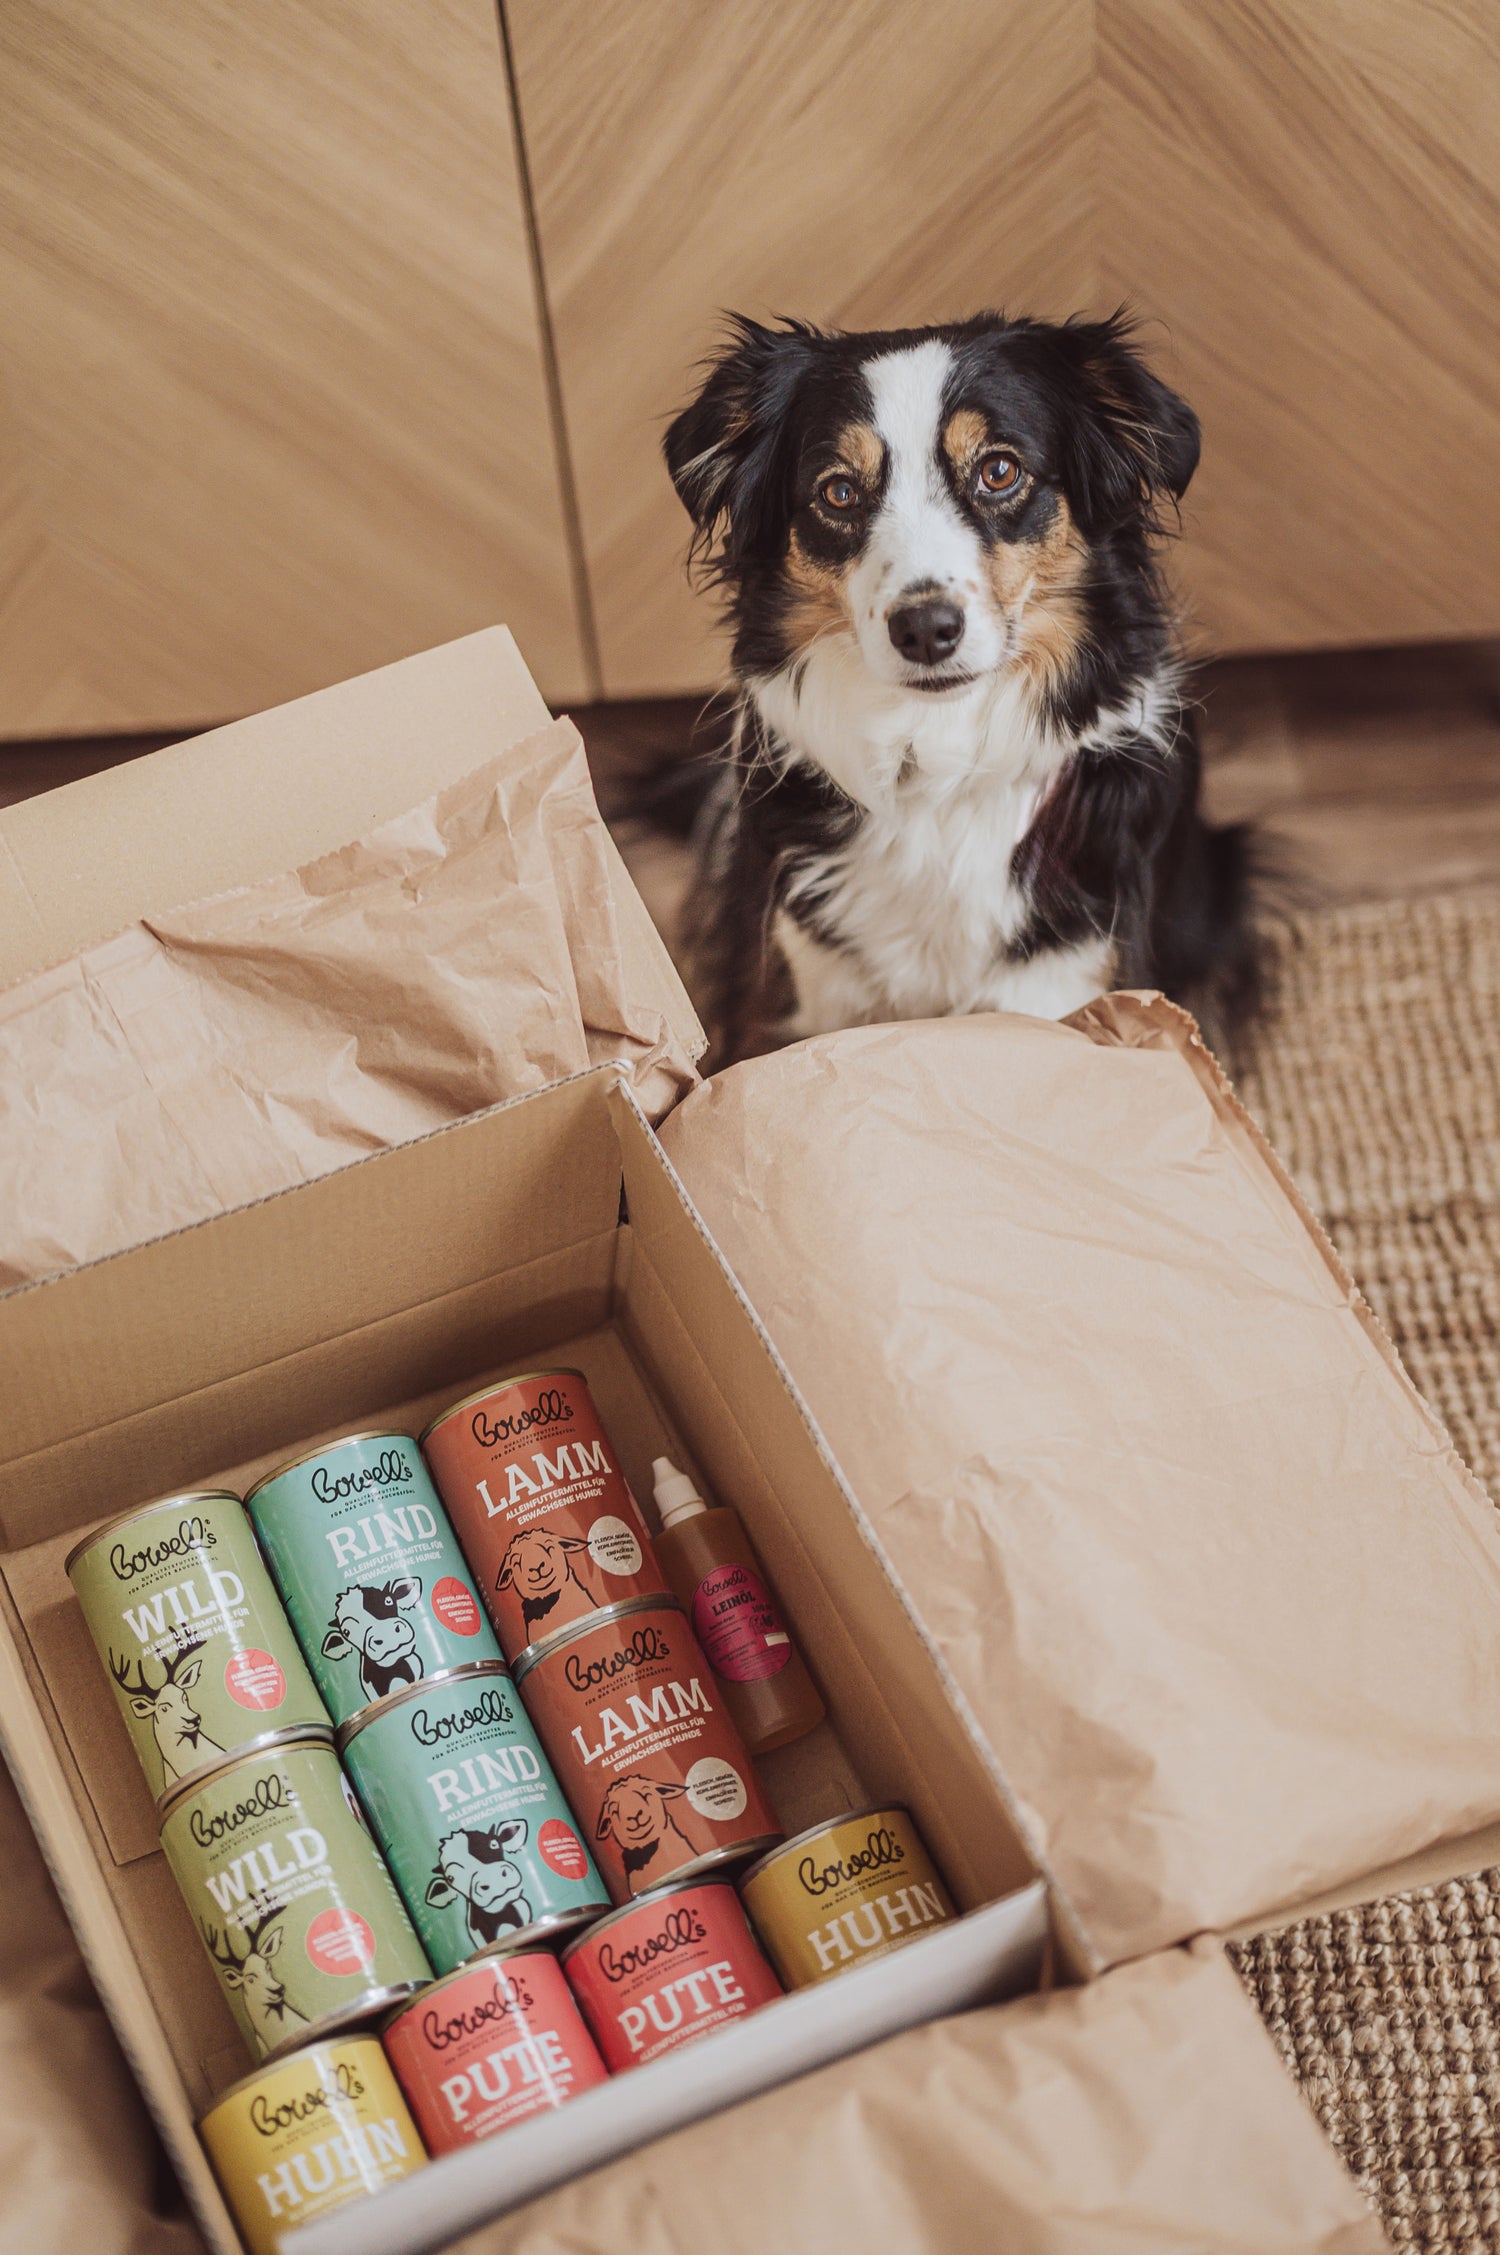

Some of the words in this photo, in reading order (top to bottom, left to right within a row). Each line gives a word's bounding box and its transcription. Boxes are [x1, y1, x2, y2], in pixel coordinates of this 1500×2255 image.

[345, 1486, 399, 1506] QUALITÄFUTTER
[476, 1440, 612, 1518] LAMM
[506, 1480, 592, 1521] ALLEINFUTTERMITTEL
[592, 1477, 606, 1488] FÜR
[518, 1495, 575, 1525] ERWACHSENE
[576, 1488, 603, 1501] HUNDE
[326, 1504, 437, 1568] RIND
[344, 1543, 430, 1578] ALLEINFUTTERMITTEL
[416, 1551, 441, 1563] HUNDE
[123, 1571, 244, 1643] WILD
[233, 1608, 249, 1618] FÜR
[712, 1590, 755, 1616] LEINÖL
[572, 1678, 713, 1765] LAMM
[601, 1722, 689, 1767] ALLEINFUTTERMITTEL
[689, 1717, 705, 1728] FÜR
[613, 1740, 672, 1772] ERWACHSENE
[672, 1730, 702, 1745] HUNDE
[427, 1745, 540, 1812] RIND
[205, 1827, 328, 1912] WILD
[808, 1882, 946, 1971] HUHN
[618, 1961, 744, 2052] PUTE
[440, 2030, 572, 2122] PUTE
[257, 2118, 408, 2218] HUHN
